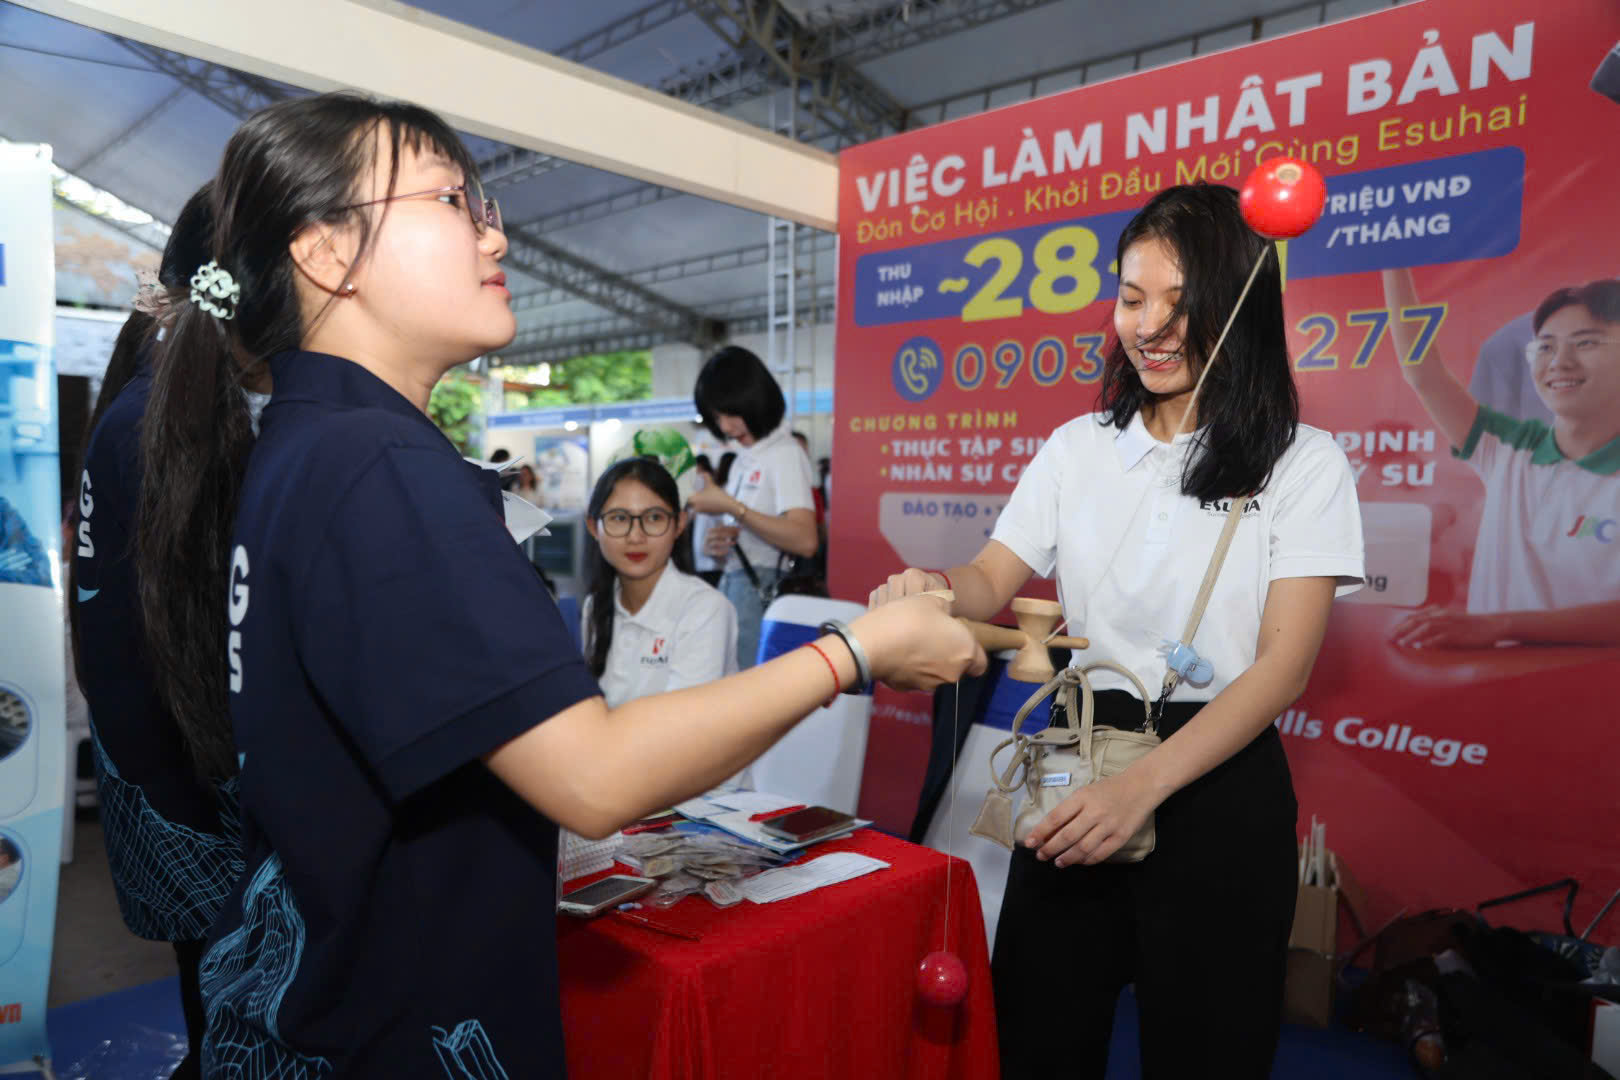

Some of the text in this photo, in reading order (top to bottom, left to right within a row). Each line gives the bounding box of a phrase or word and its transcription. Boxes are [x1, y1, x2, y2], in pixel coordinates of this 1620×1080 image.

[856, 21, 1535, 215] VIỆC LÀM NHẬT BẢN
[856, 217, 904, 244] Đón
[911, 208, 947, 233] Cơ
[955, 196, 999, 229] Hội
[1174, 149, 1241, 186] Mới
[1378, 94, 1529, 151] Esuhai
[1322, 175, 1472, 216] RIỆU VNĐ
[1326, 213, 1451, 248] /THÁNG
[877, 262, 912, 282] THU
[954, 302, 1449, 390] 0903 277
[1333, 716, 1489, 767] College
